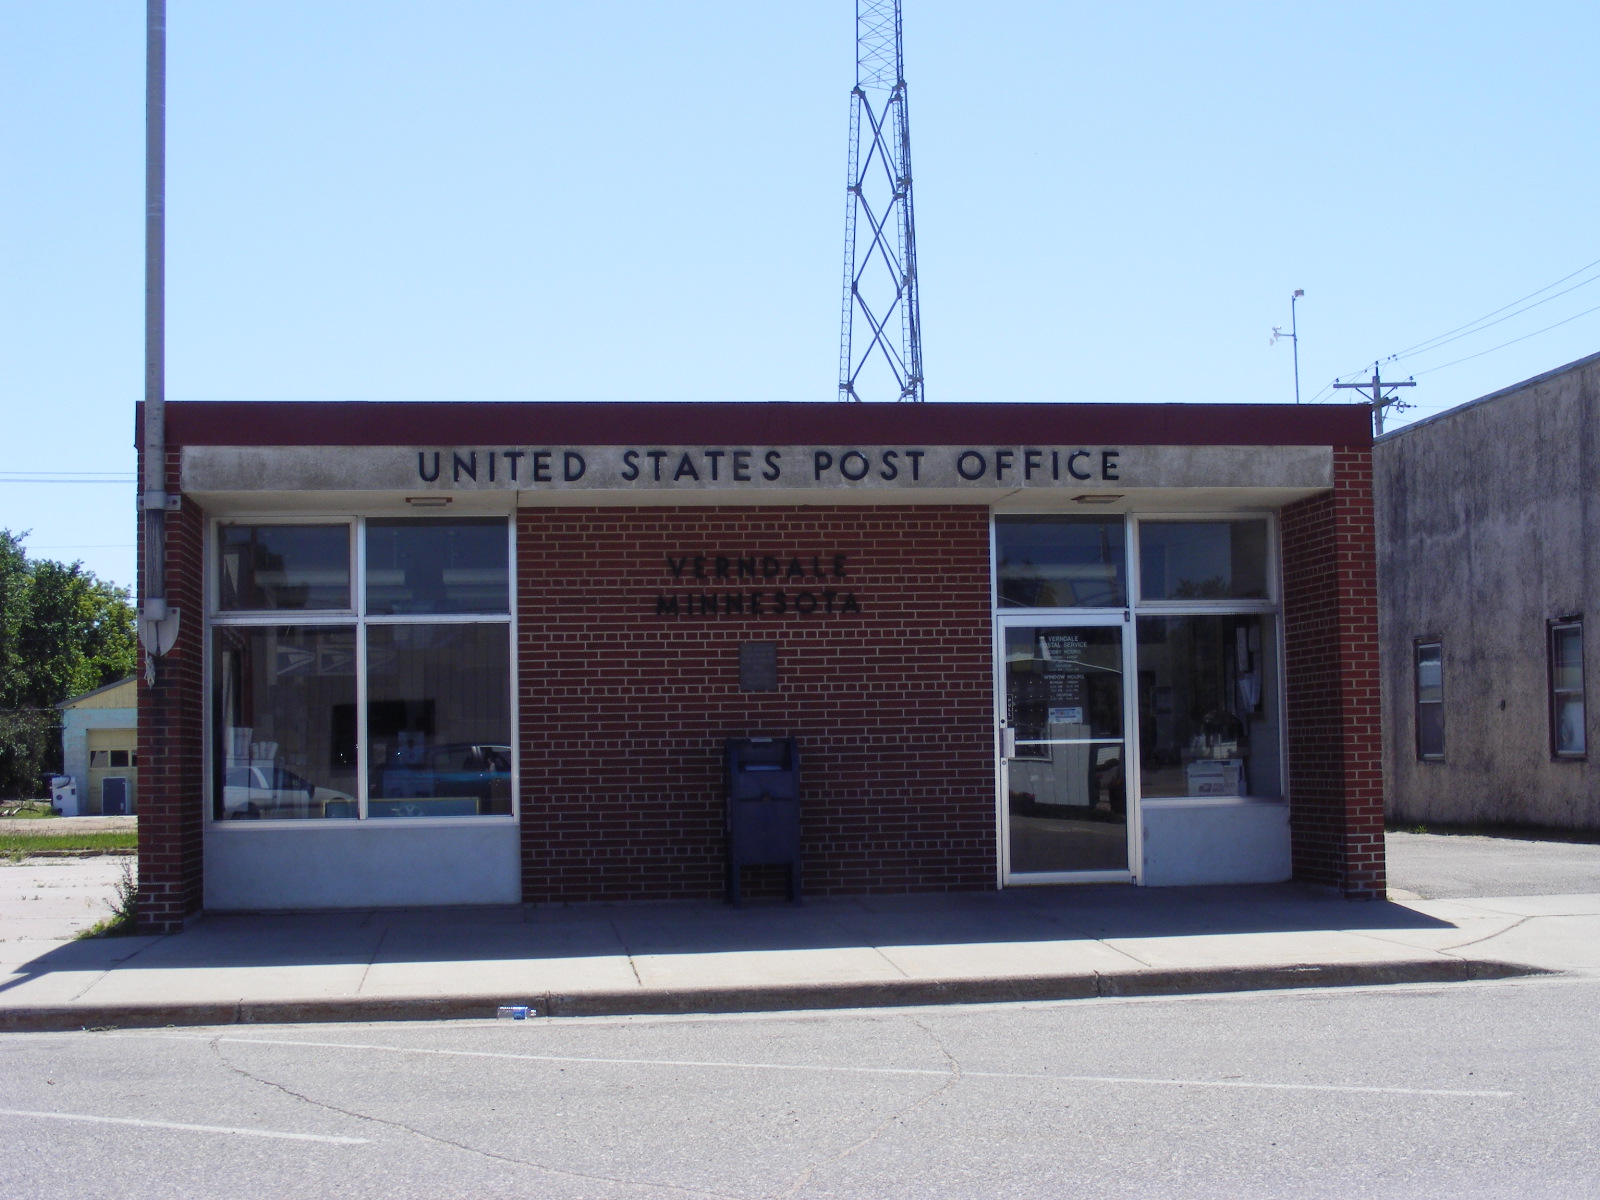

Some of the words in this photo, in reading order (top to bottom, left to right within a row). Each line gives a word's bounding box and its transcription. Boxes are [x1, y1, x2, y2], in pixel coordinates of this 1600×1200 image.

[418, 451, 587, 483] UNITED
[622, 450, 781, 482] STATES
[813, 450, 925, 482] POST
[956, 450, 1120, 481] OFFICE
[667, 554, 847, 579] VERNDALE
[656, 590, 861, 616] MINNESOTA
